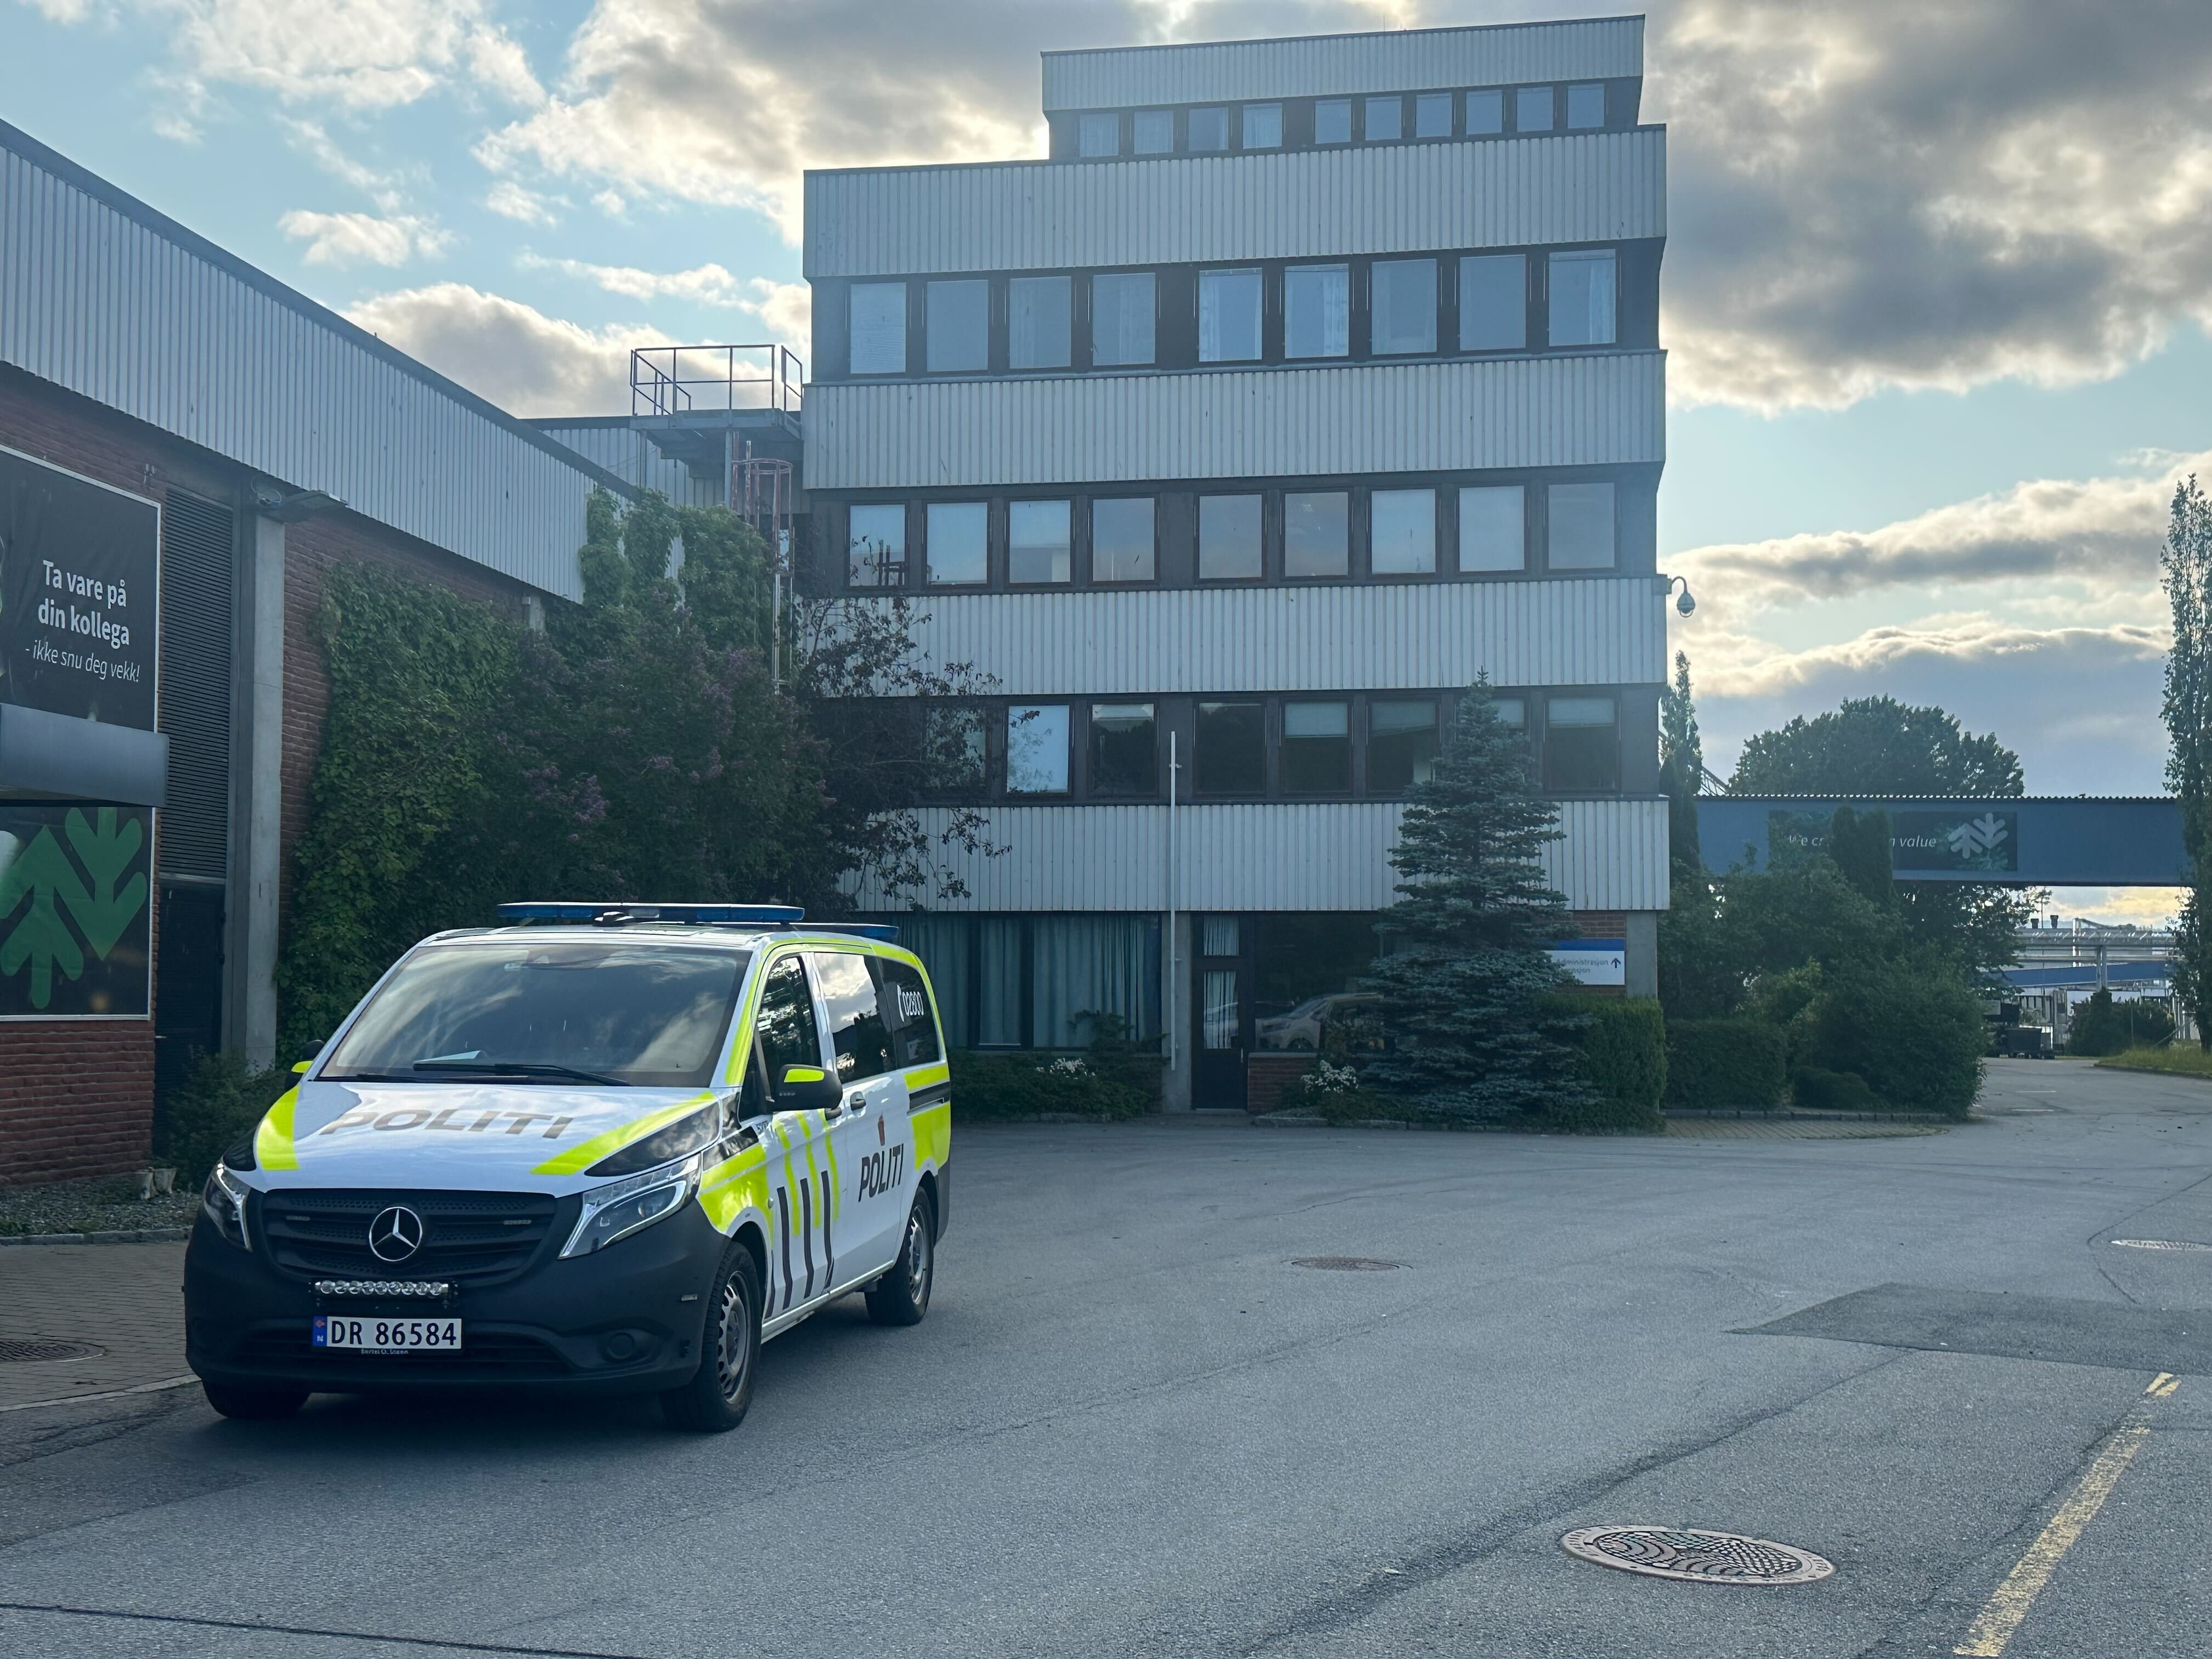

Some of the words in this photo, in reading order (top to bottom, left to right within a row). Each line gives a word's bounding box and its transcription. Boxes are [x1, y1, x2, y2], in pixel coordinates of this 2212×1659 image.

[43, 560, 62, 589] Ta
[67, 572, 103, 600] vare
[108, 579, 127, 609] på
[38, 598, 65, 629] din
[70, 605, 129, 649] kollega
[33, 640, 58, 663] ikke
[60, 652, 82, 669] snu
[86, 653, 107, 680] deg
[111, 661, 140, 682] vekk!
[1900, 835, 1937, 847] value
[319, 1109, 574, 1139] POLITI
[858, 1143, 904, 1202] POLITI
[331, 1321, 362, 1345] DR
[375, 1322, 456, 1346] 86584
